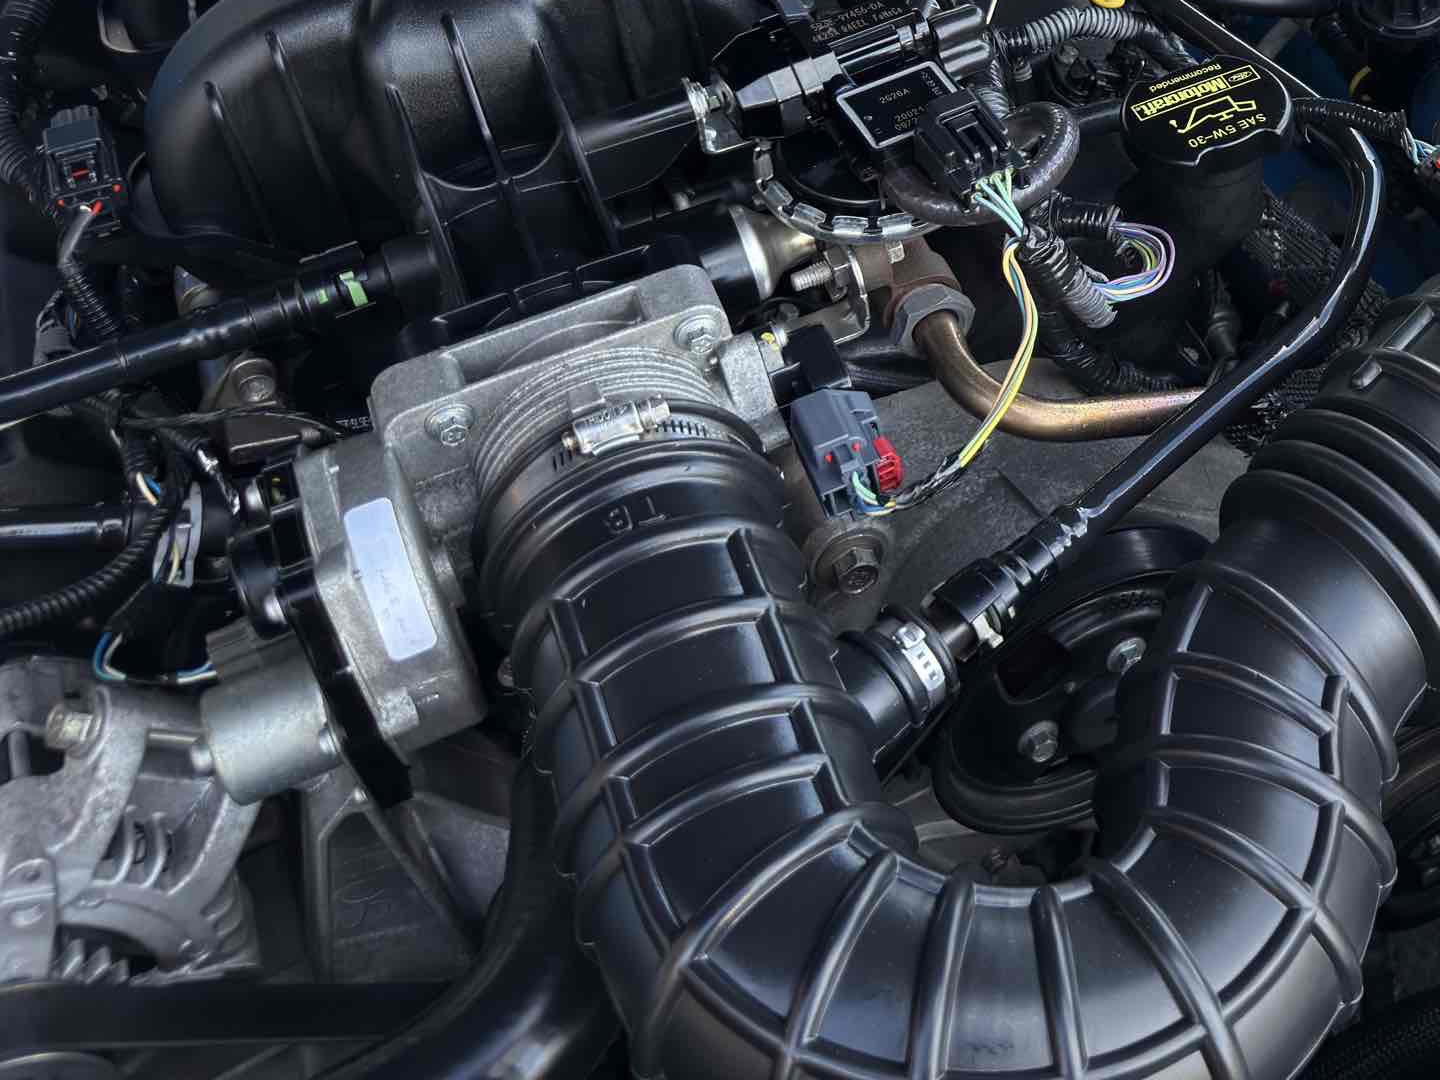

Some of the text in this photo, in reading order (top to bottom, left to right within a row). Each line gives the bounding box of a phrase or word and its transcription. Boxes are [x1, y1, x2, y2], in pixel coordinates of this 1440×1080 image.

[1148, 62, 1222, 93] Recommended
[1140, 77, 1227, 116] Motorcraft
[1187, 113, 1267, 149] SAE 5W-30
[601, 495, 666, 534] TB
